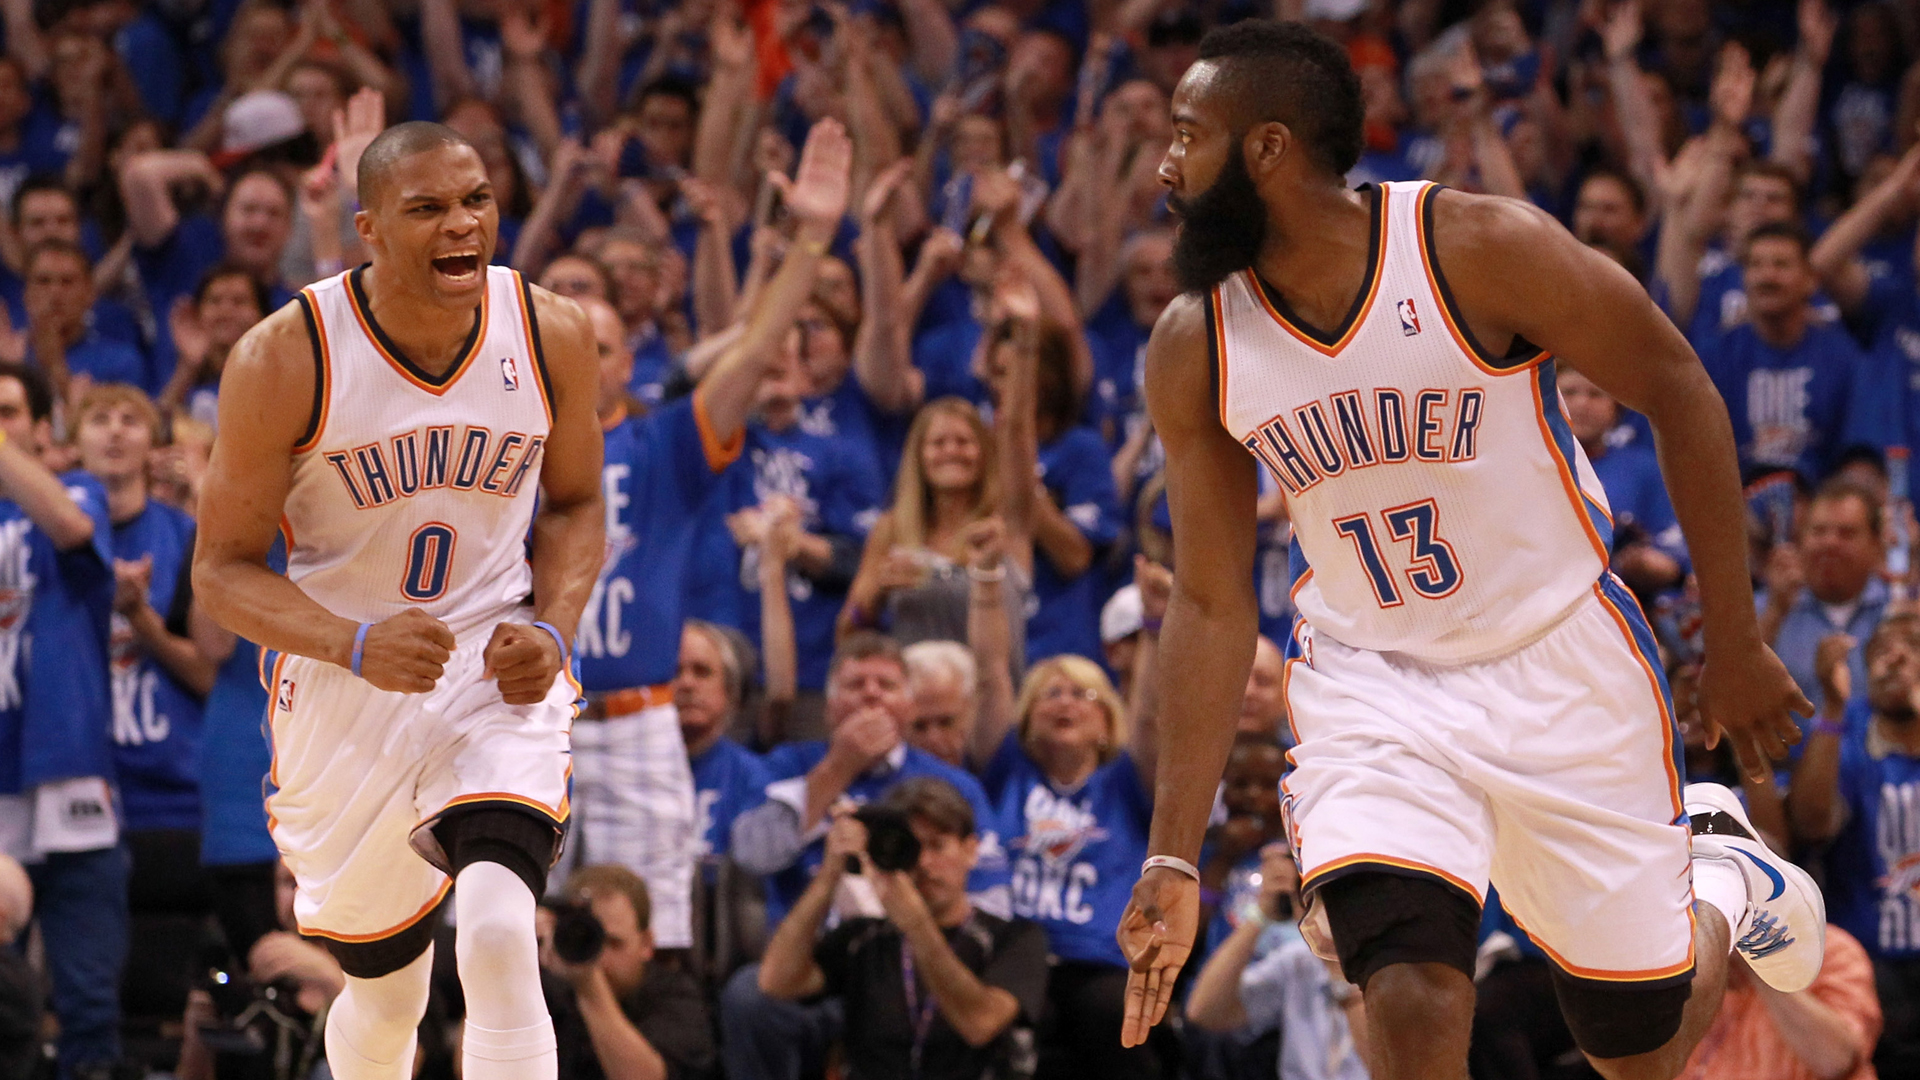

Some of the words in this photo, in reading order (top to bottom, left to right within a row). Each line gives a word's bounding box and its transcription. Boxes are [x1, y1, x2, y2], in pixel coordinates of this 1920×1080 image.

[322, 425, 545, 511] THUNDER
[1240, 388, 1485, 498] THUNDER
[400, 521, 458, 603] 0
[1331, 497, 1465, 609] 13
[579, 576, 636, 659] KC
[110, 669, 171, 746] KC
